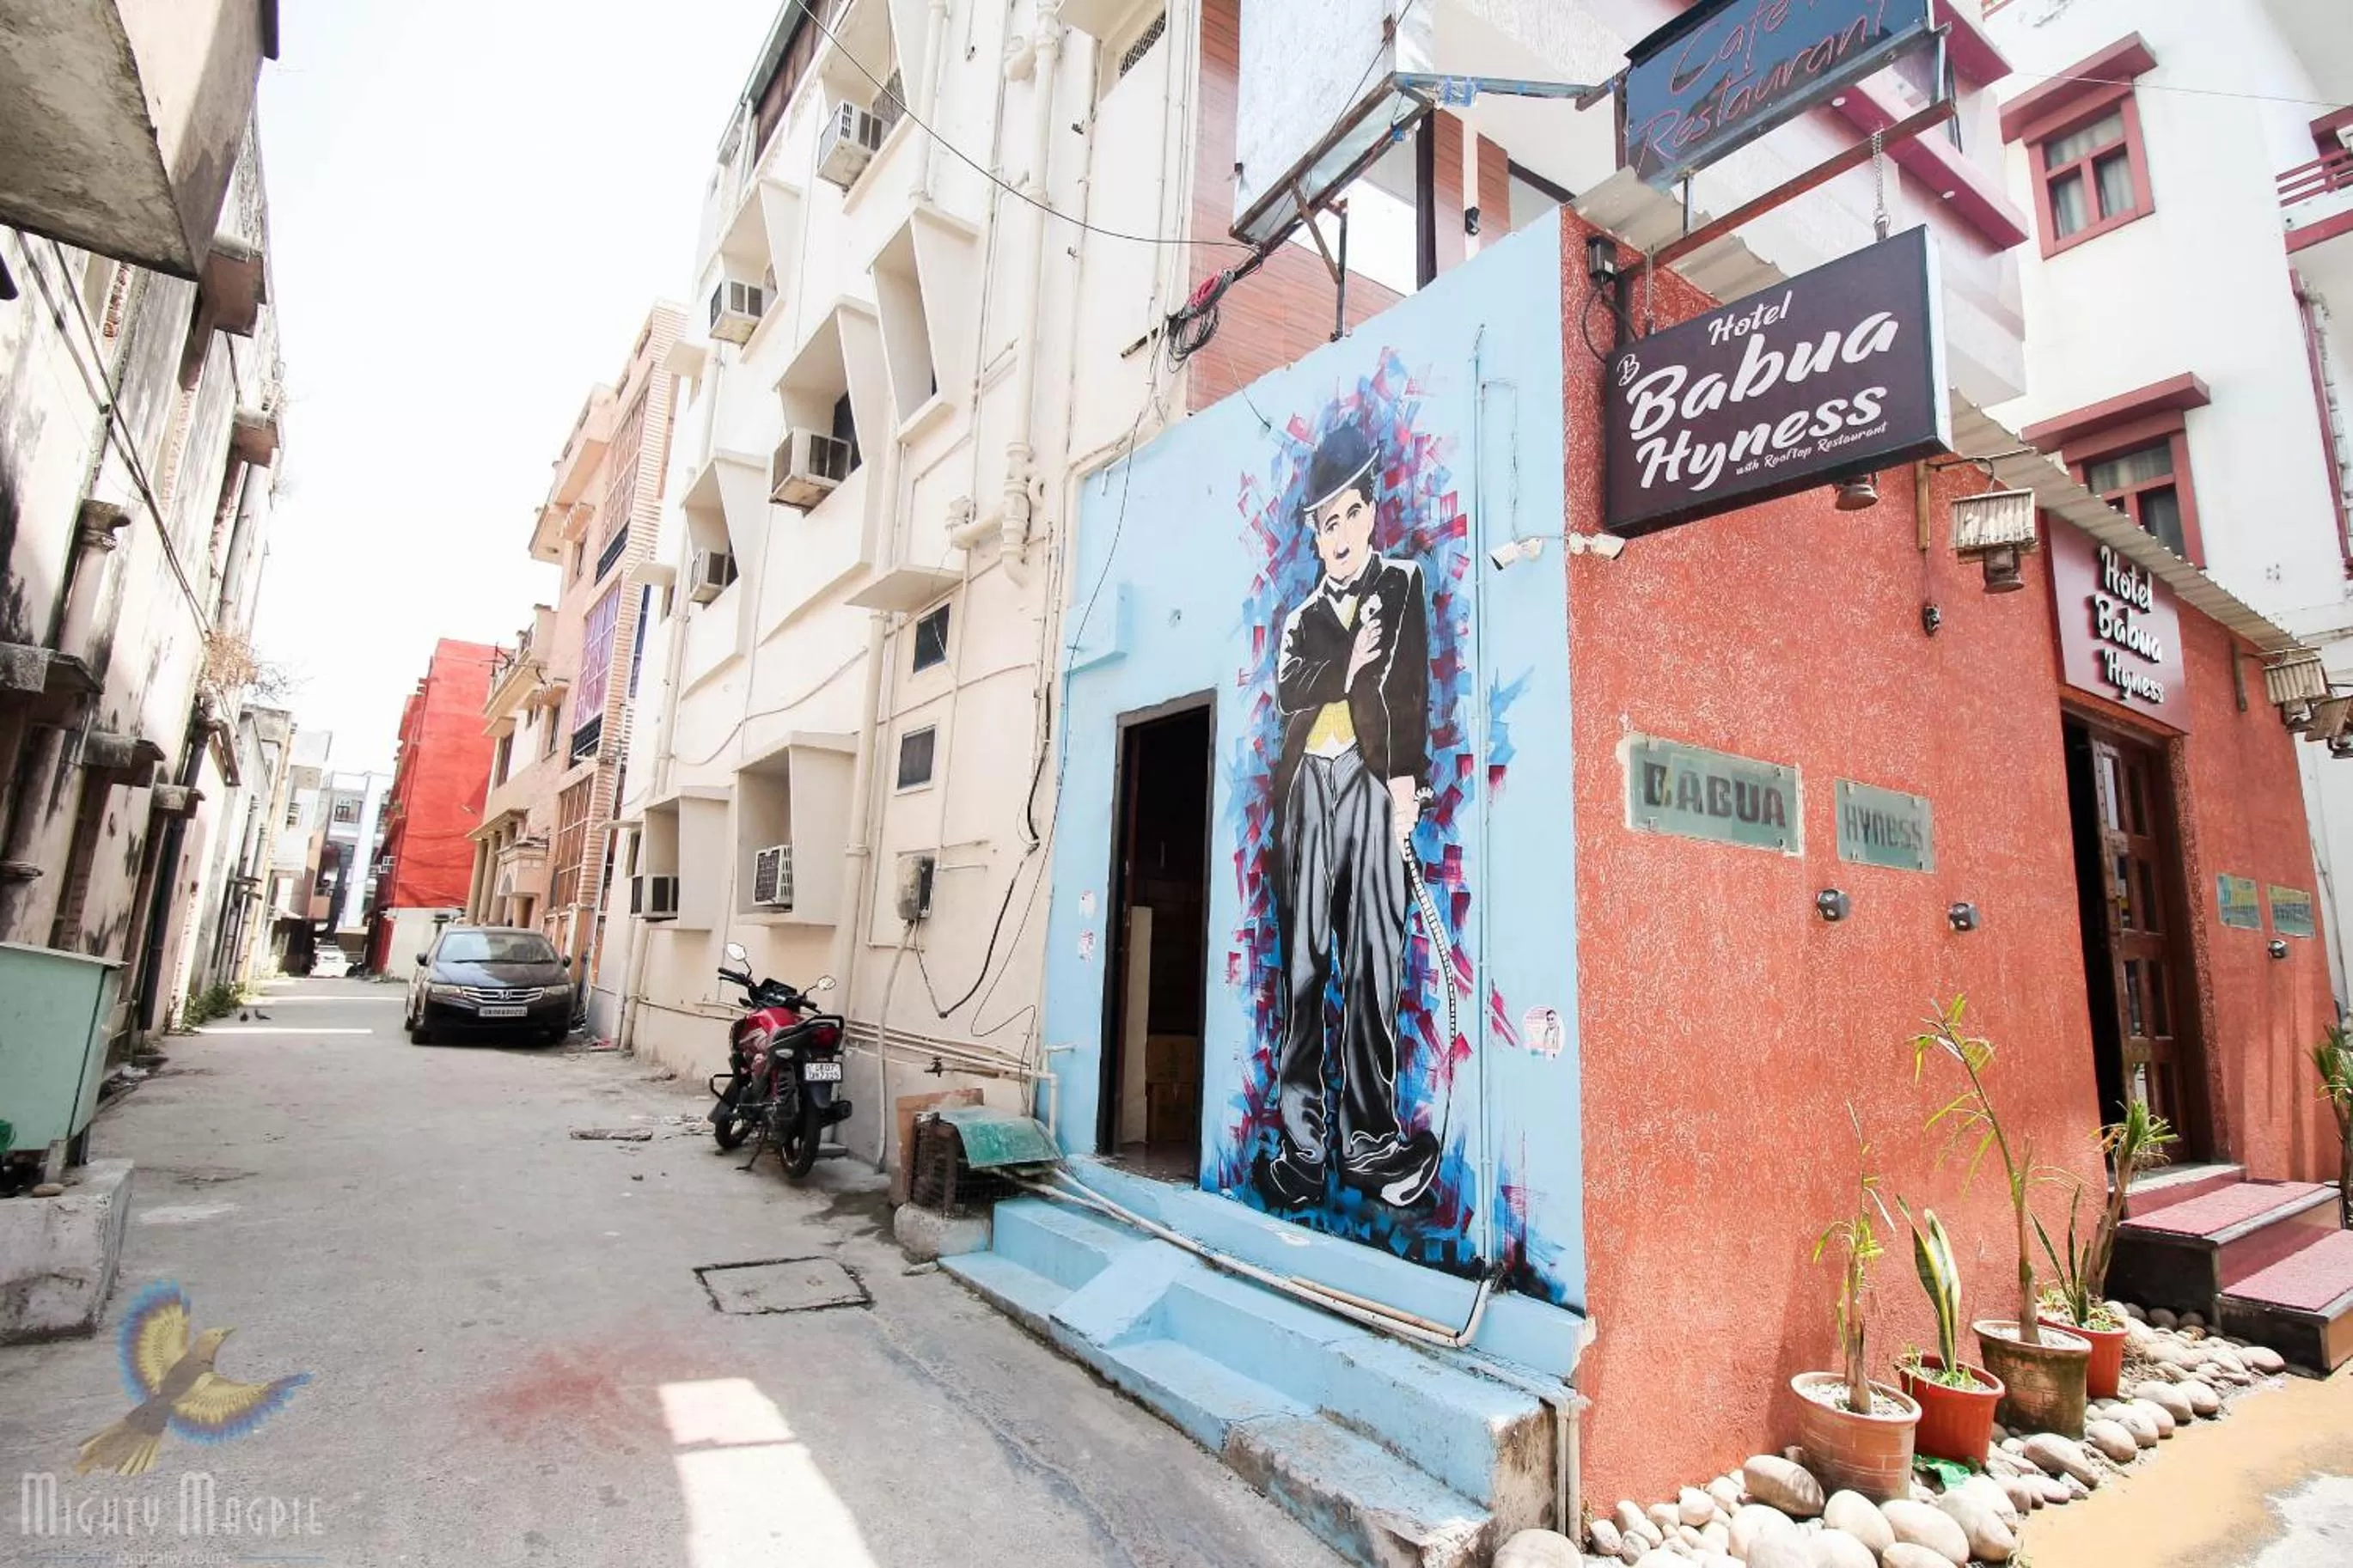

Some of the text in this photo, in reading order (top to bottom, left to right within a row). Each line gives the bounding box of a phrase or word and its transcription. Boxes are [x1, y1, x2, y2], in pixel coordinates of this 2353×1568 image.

[1708, 290, 1793, 345] Hotel
[1626, 310, 1898, 441] Babua
[1635, 386, 1887, 491] Hyness
[1763, 446, 1812, 468] Rooftop
[1818, 420, 1887, 452] Restaurant
[2099, 545, 2154, 610] Hotel
[2094, 593, 2162, 662] Babua
[2103, 649, 2164, 703] Hyness
